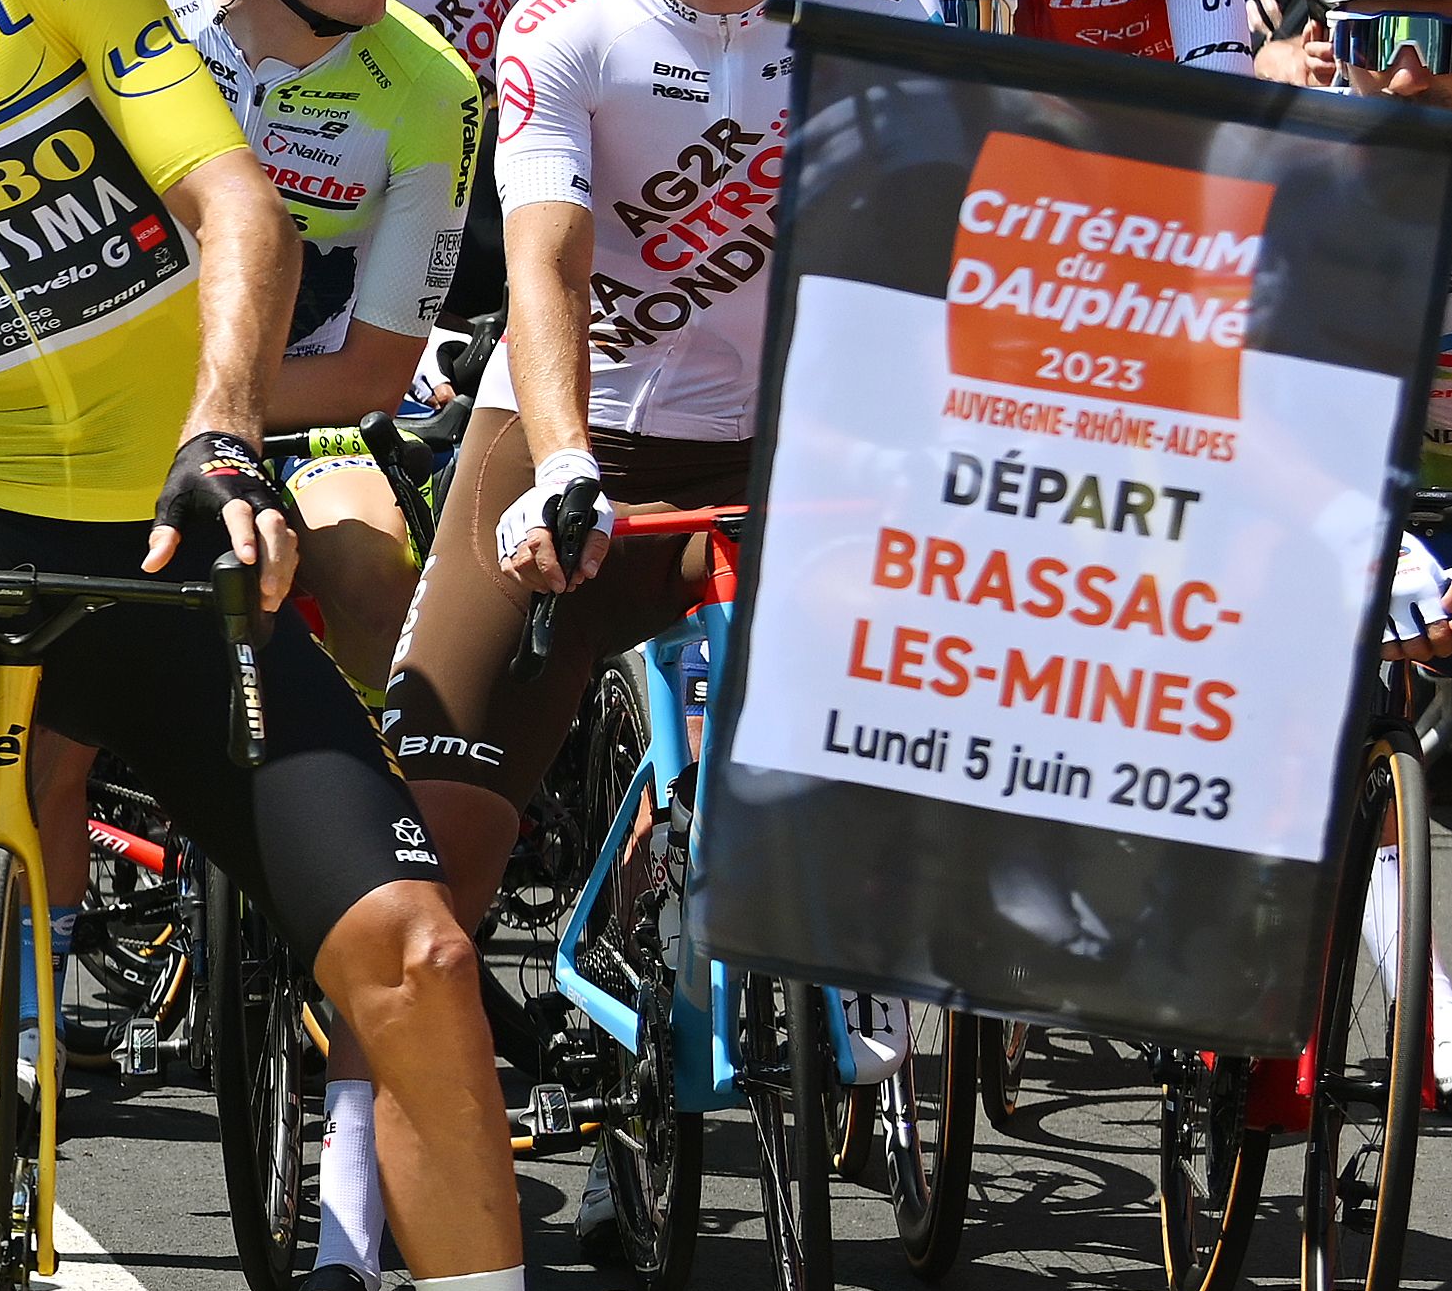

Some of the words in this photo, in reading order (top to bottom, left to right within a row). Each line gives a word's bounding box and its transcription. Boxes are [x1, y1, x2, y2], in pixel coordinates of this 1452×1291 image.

[357, 48, 392, 90] RUFFUS
[652, 61, 711, 83] BMC
[299, 90, 361, 101] CUBE
[301, 105, 350, 120] bryton
[289, 142, 342, 167] Nalini
[457, 94, 481, 208] Wallonie
[611, 117, 765, 238] AG2R
[1057, 253, 1103, 284] du
[82, 279, 146, 318] SRAM
[1038, 346, 1144, 392] 2023
[943, 389, 1237, 463] AUVERGNE-RHÔNE-ALPES
[942, 449, 1202, 541] DÉPART
[872, 527, 1242, 645] BRASSAC-
[238, 643, 265, 743] SRAM
[847, 617, 1238, 743] LES-MINES
[398, 735, 505, 766] BMC
[823, 709, 949, 776] Lundi
[963, 741, 990, 780] 5
[1002, 745, 1091, 802] juin
[1111, 763, 1232, 822] 2023
